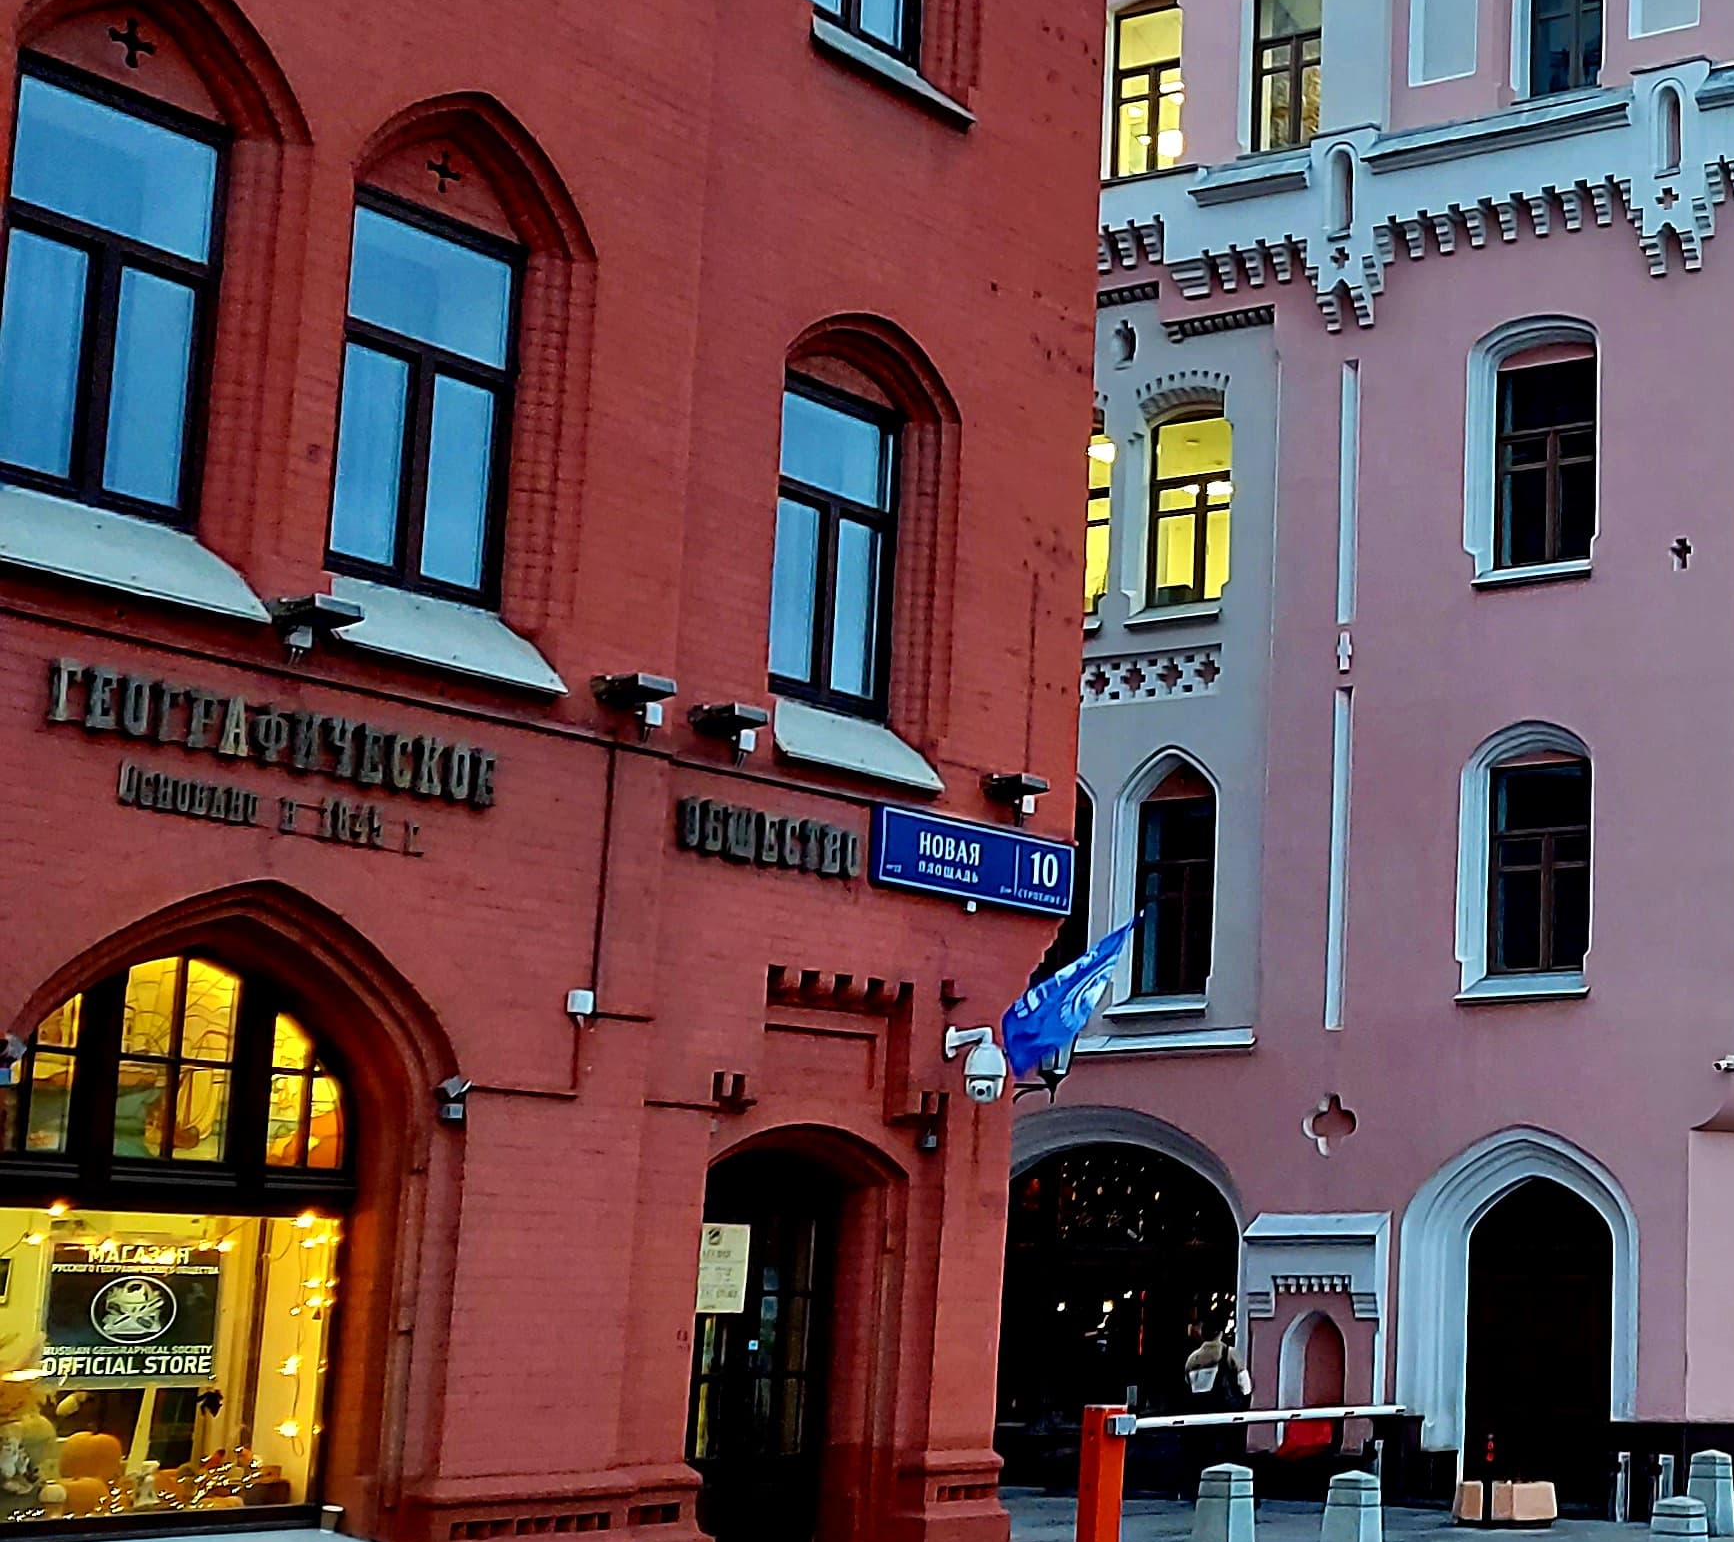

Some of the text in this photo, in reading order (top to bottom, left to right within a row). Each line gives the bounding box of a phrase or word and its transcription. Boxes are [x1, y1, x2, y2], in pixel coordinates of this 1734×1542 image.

[48, 658, 497, 807] ГЕОГРАФИЧЕСКОЕ
[679, 796, 861, 878] ОБЩЕСТВО
[918, 831, 981, 867] НОВАЯ
[918, 860, 980, 884] ПЛОЩАДЬ
[1030, 851, 1059, 888] 10
[42, 1355, 212, 1376] OFFICIAL STORE
[171, 1345, 213, 1355] SOCIETY
